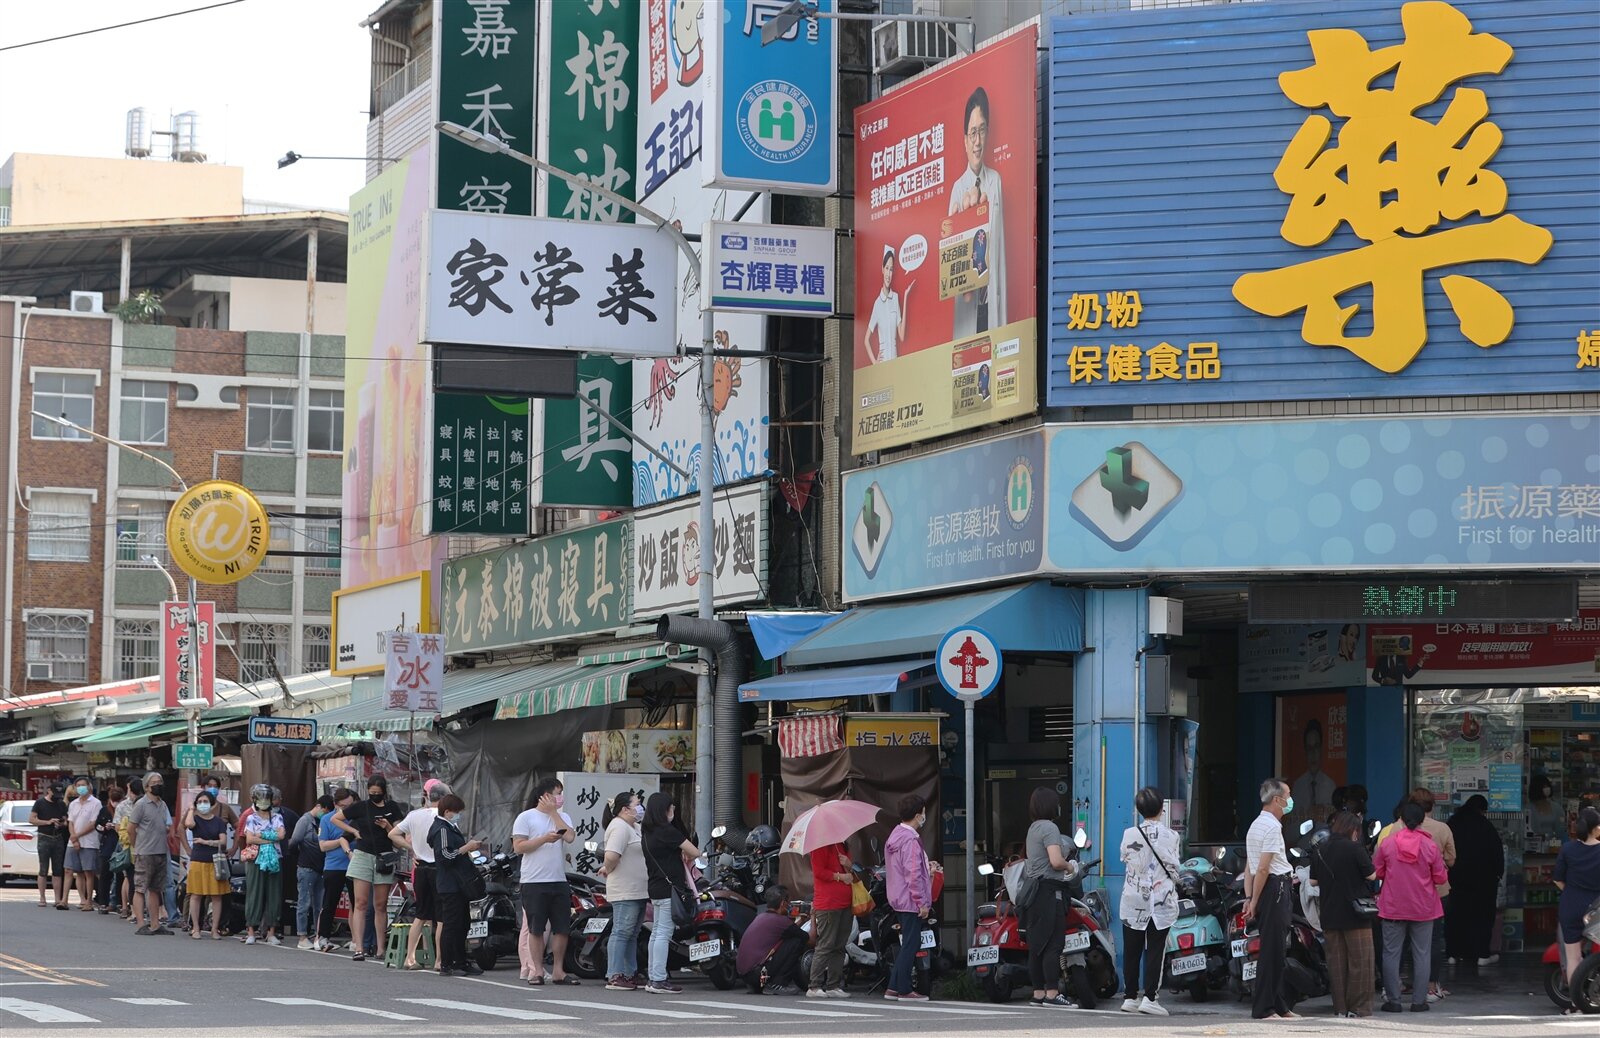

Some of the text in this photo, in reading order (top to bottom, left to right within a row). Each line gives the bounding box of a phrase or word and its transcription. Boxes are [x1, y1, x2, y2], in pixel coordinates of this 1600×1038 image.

[644, 99, 702, 194] 王記
[740, 117, 814, 160] NATIONAL HEALTH INSURANCE
[870, 122, 945, 181] 任何感冒不適
[446, 237, 658, 326] 家常菜
[720, 260, 825, 296] 杏輝專櫃
[1067, 290, 1143, 331] 奶粉
[1066, 342, 1222, 384] 保健食品
[857, 410, 895, 437] 大正百保能
[462, 425, 476, 513] 床墊壁紙
[485, 426, 500, 514] 拉門地磚
[509, 428, 524, 514] 家飾布品
[250, 516, 262, 556] TRUE
[927, 504, 1001, 548] 振源藥妝
[1458, 525, 1502, 544] First
[1508, 524, 1536, 544] for
[638, 528, 679, 593] 炒飯
[926, 539, 1035, 568] First for health. First for you
[452, 530, 614, 645] 元泰棉被寢具
[1362, 585, 1457, 616] 熱銷中
[391, 635, 440, 656] 吉林
[396, 655, 431, 689] 冰
[255, 722, 312, 740] Mr.地瓜球
[182, 757, 196, 767] 121
